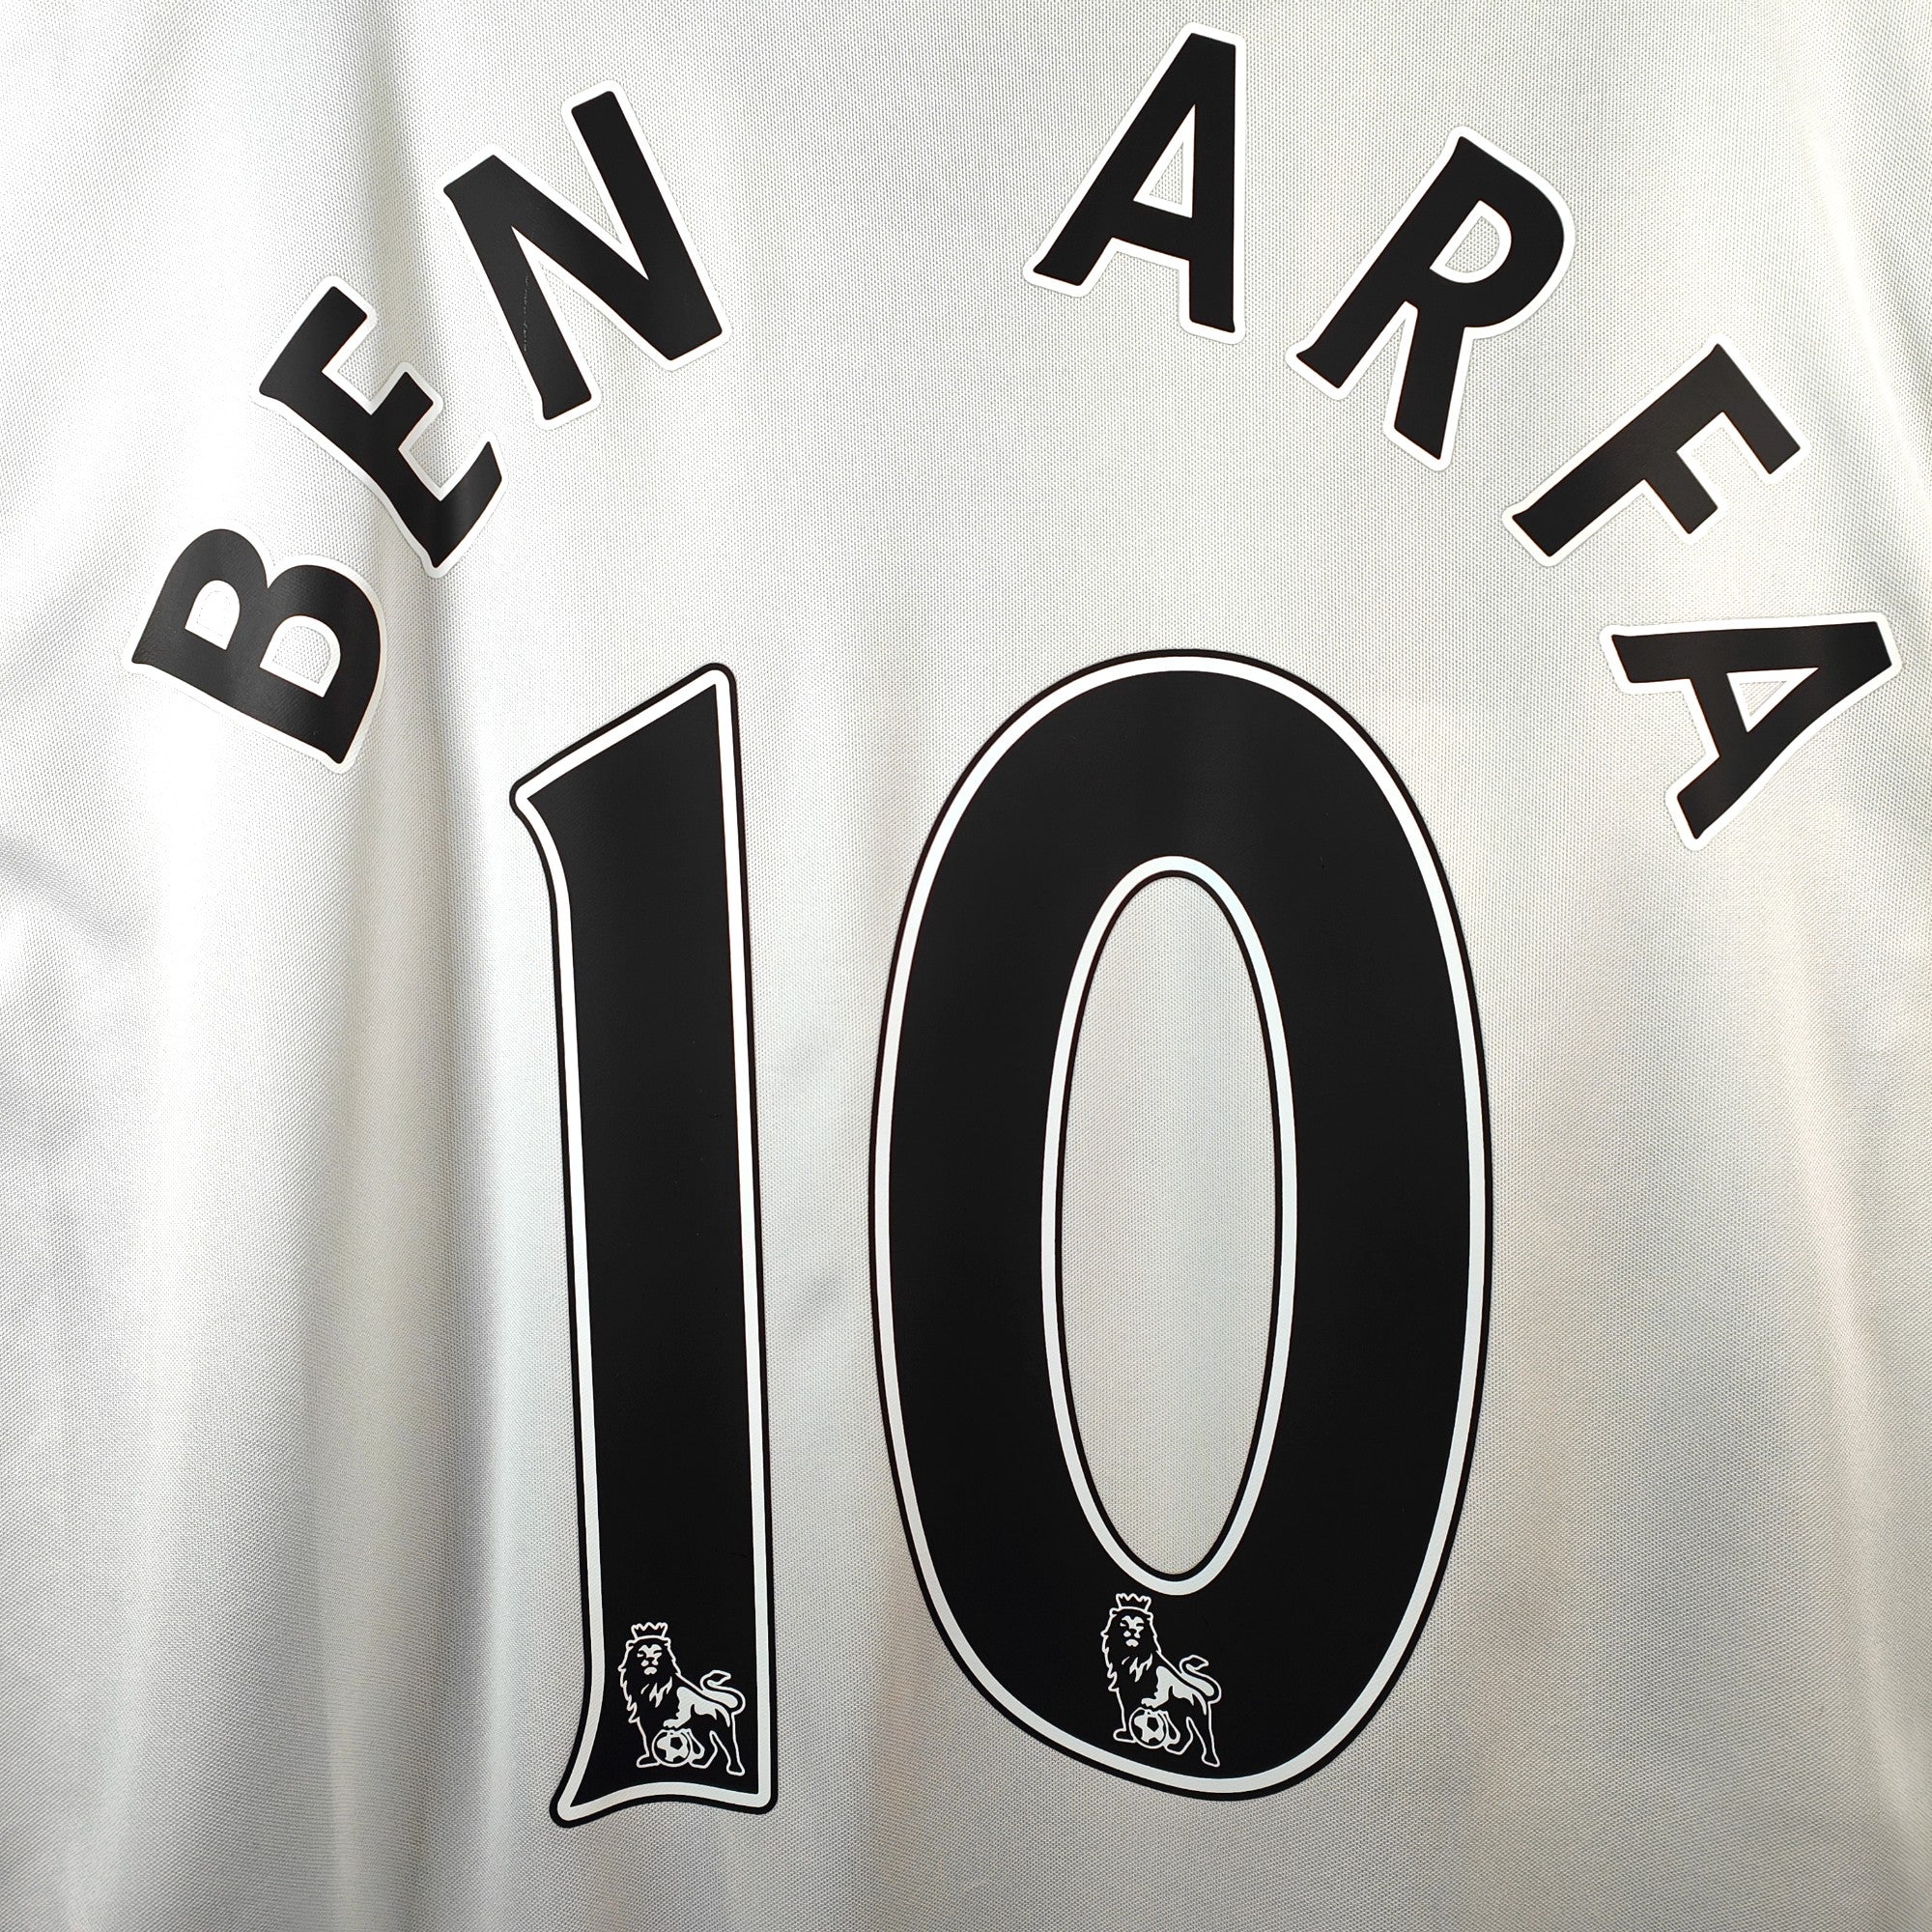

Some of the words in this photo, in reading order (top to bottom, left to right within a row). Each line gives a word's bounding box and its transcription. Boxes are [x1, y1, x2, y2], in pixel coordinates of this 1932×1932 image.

[131, 90, 724, 764] BEN
[1030, 33, 1893, 840] ARFA
[510, 648, 1494, 1829] 10
